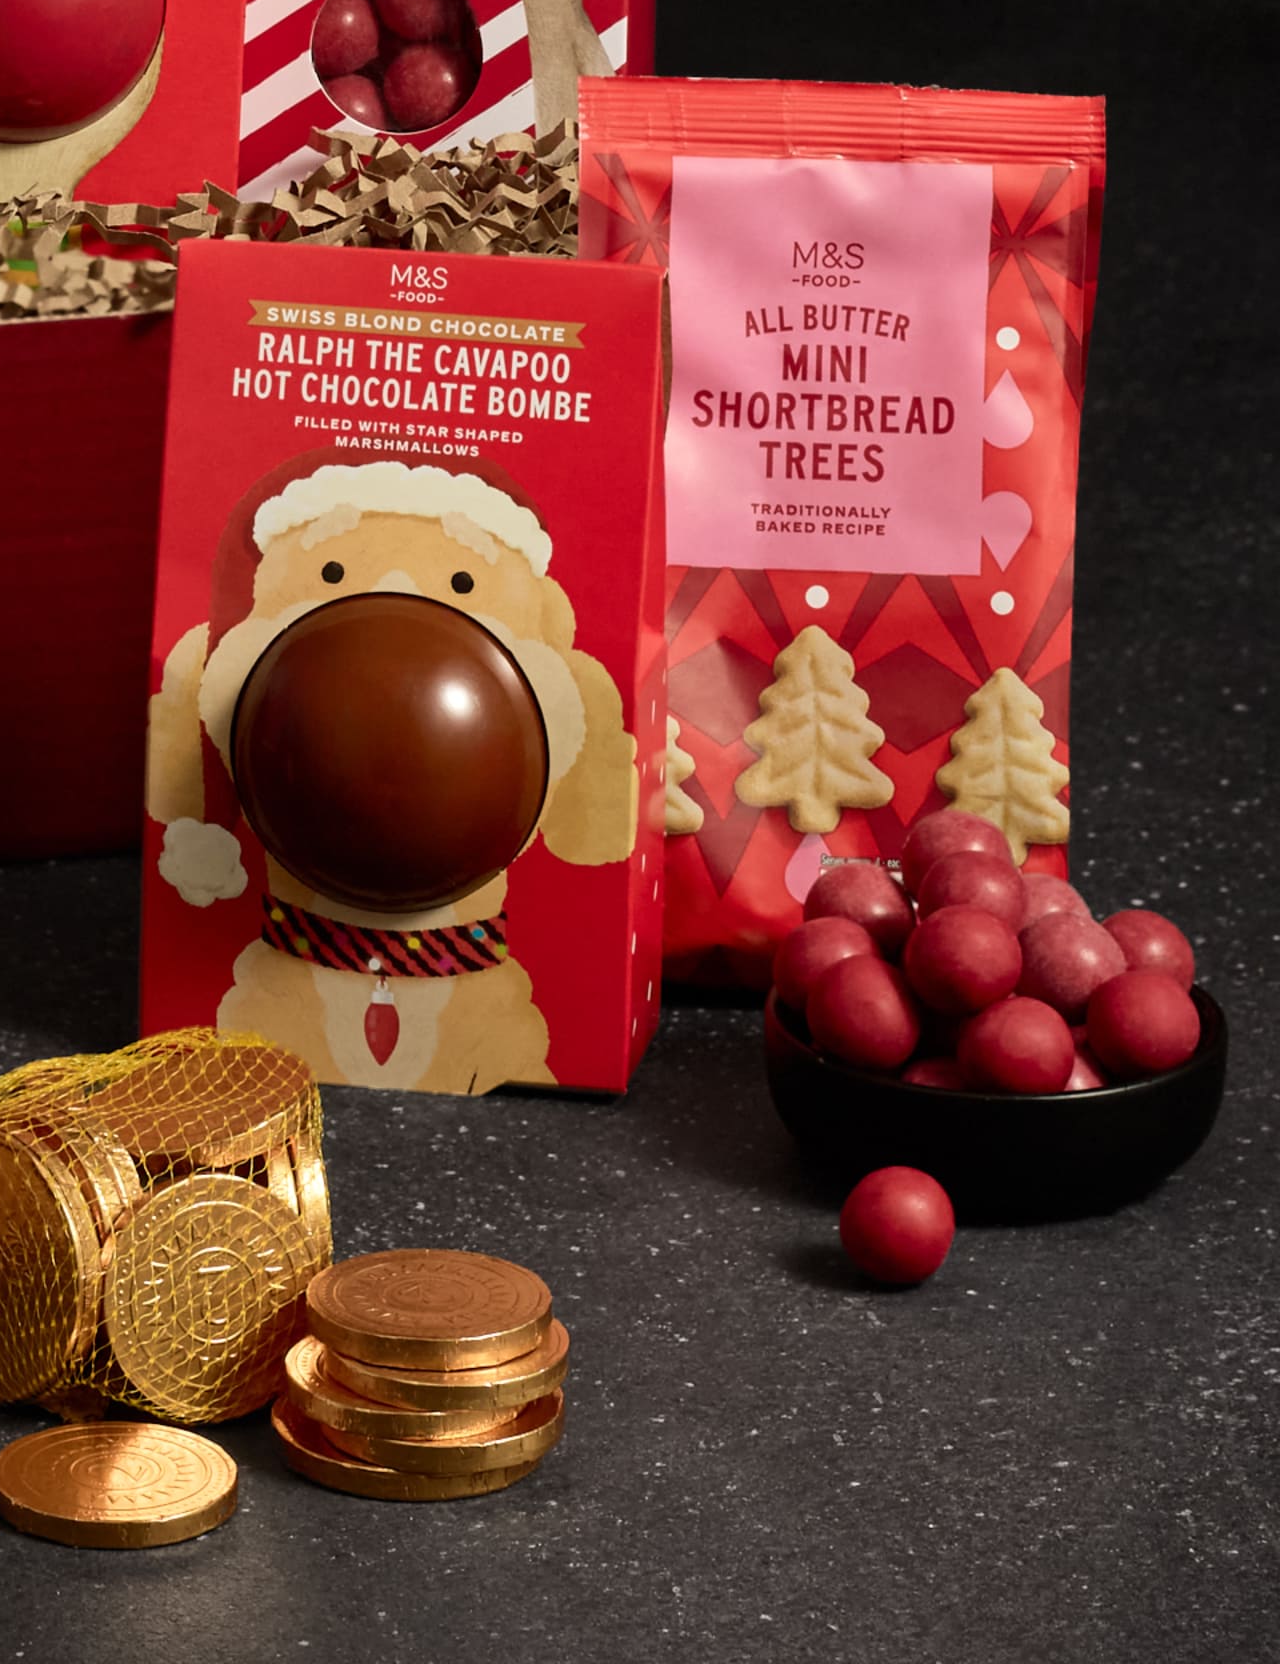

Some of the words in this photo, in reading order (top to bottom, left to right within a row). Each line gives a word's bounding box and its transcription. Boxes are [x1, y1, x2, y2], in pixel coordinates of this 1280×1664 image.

[793, 242, 864, 269] M&S
[392, 265, 447, 289] M&S
[268, 307, 335, 325] SWISS
[345, 313, 421, 331] BLOND
[430, 319, 564, 342] CHOCOLATE
[746, 306, 793, 336] ALL
[804, 305, 909, 341] BUTTER
[259, 333, 354, 367] RALPH
[367, 340, 423, 372] THE
[435, 345, 569, 383] CAVAPOO
[783, 344, 866, 383] MINI
[233, 368, 291, 399] HOT
[302, 373, 476, 413] CHOCOLATE
[488, 387, 591, 422] BOMBE
[693, 390, 954, 434] SHORTBREAD
[295, 416, 352, 430] FILLED
[359, 421, 399, 434] WITH
[407, 424, 448, 437] STAR
[455, 428, 522, 442] SHAPED
[336, 436, 478, 456] MARSHMALLOWS
[760, 442, 884, 482] TREES
[752, 504, 890, 518] TRADITIONALLY
[757, 521, 815, 533] BAKED
[823, 523, 884, 535] RECIPE
